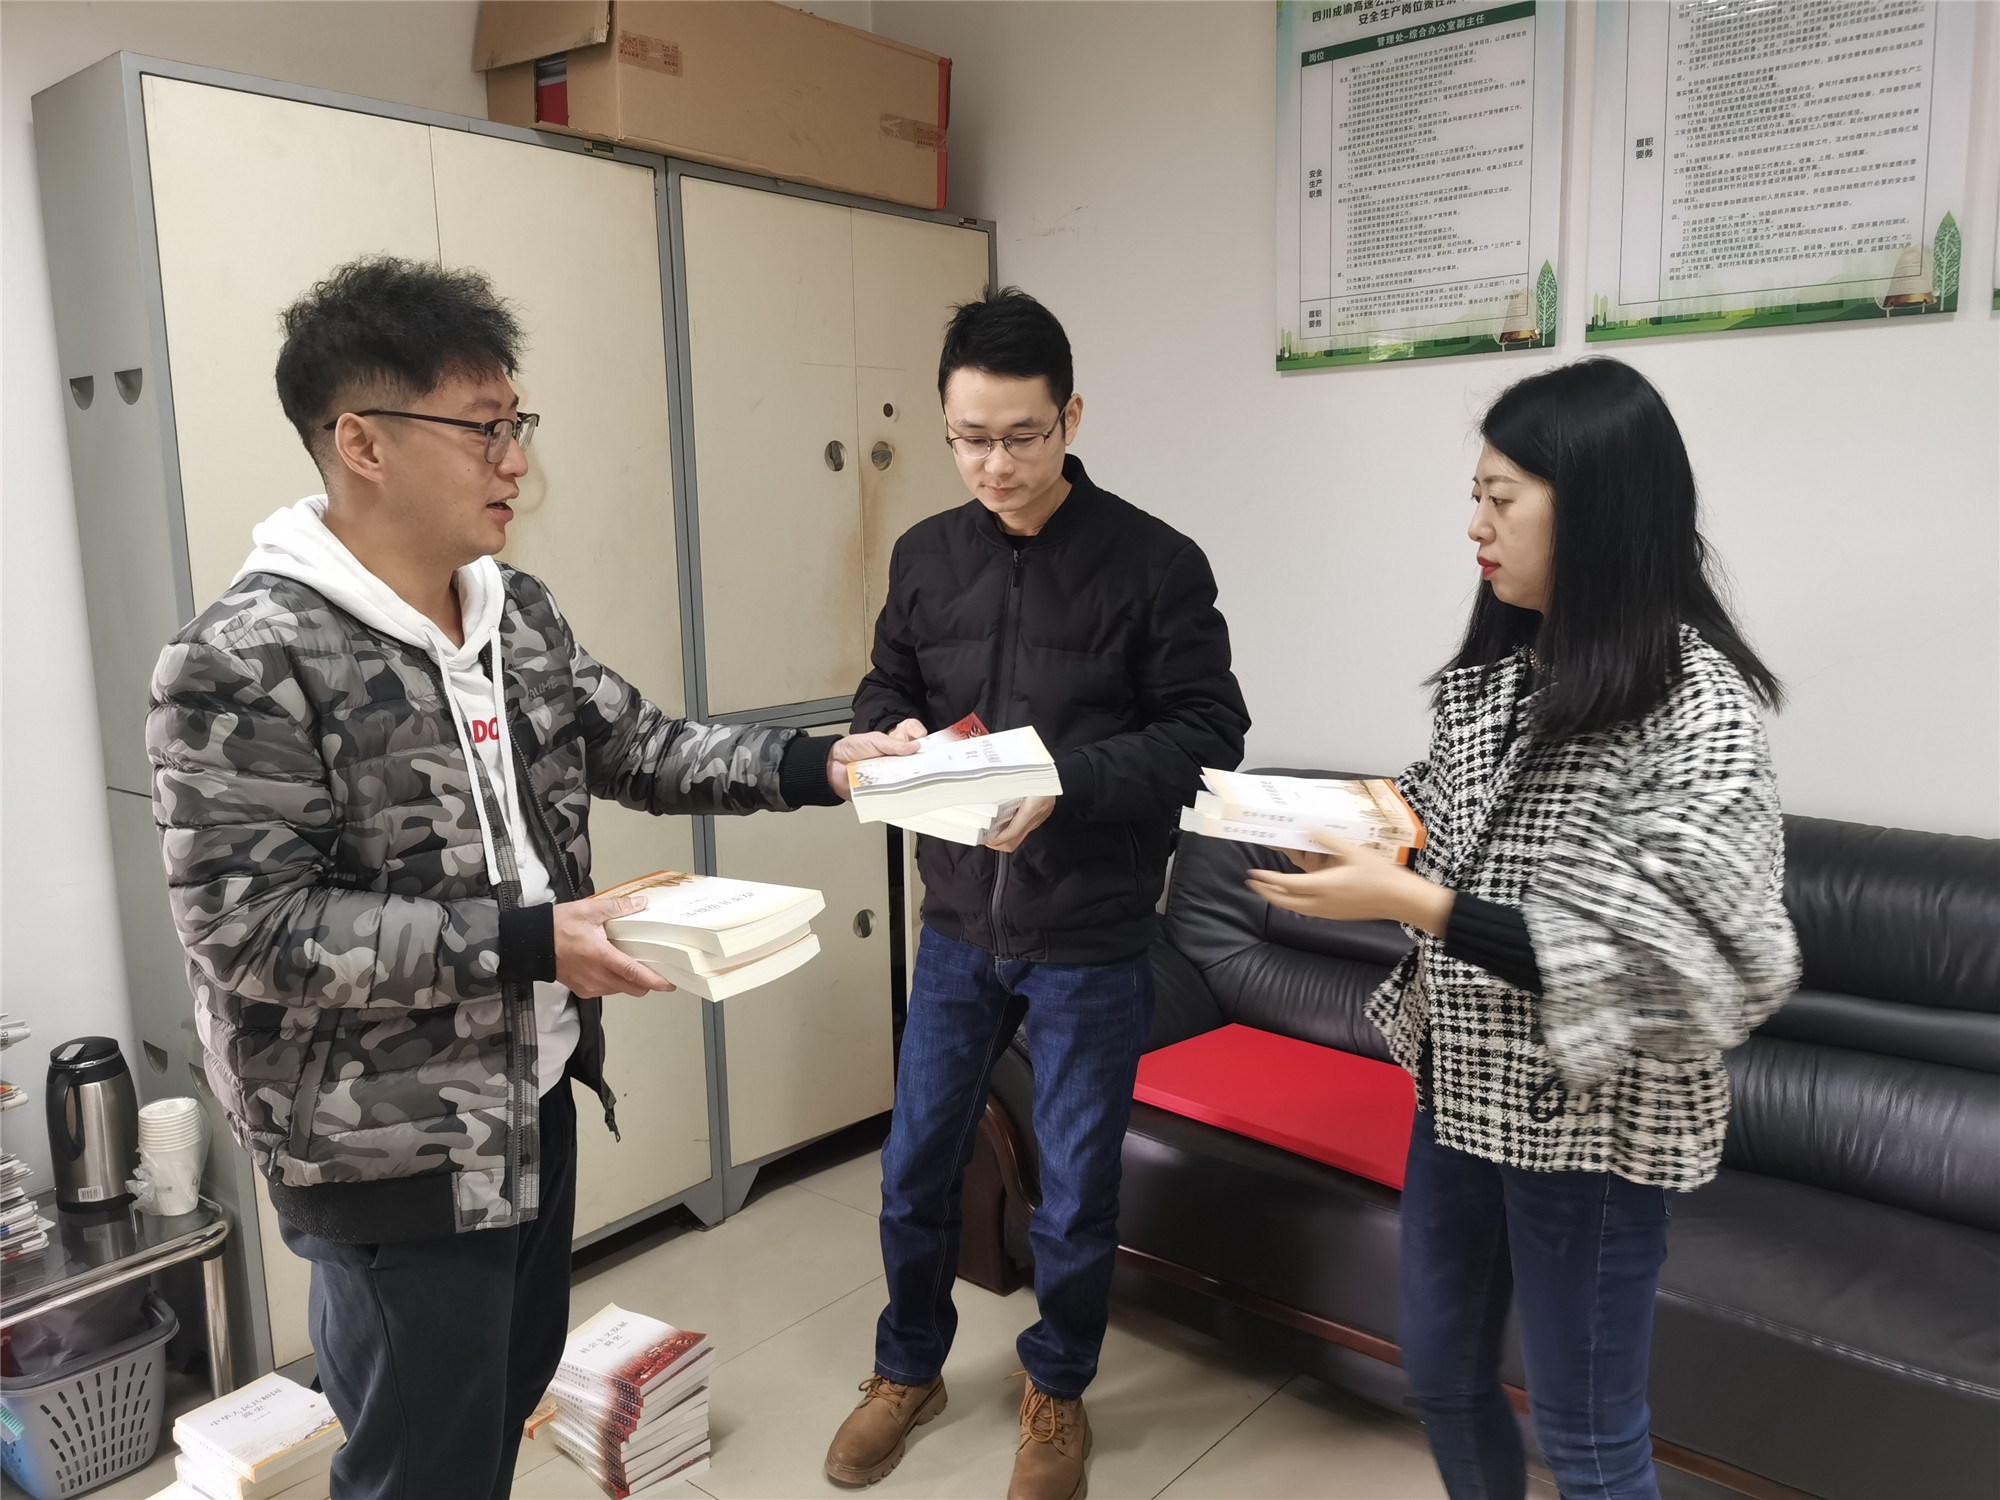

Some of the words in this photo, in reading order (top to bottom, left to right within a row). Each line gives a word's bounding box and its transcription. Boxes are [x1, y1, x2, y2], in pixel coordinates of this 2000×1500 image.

[1358, 0, 1464, 26] 安全生产岗位责任清
[1308, 51, 1324, 63] 岗位
[1636, 137, 1654, 148] 履职
[1636, 148, 1653, 159] 要务
[1309, 168, 1322, 178] 安全
[1309, 179, 1322, 188] 生产
[1309, 190, 1322, 198] 职责
[1308, 320, 1322, 328] 要务
